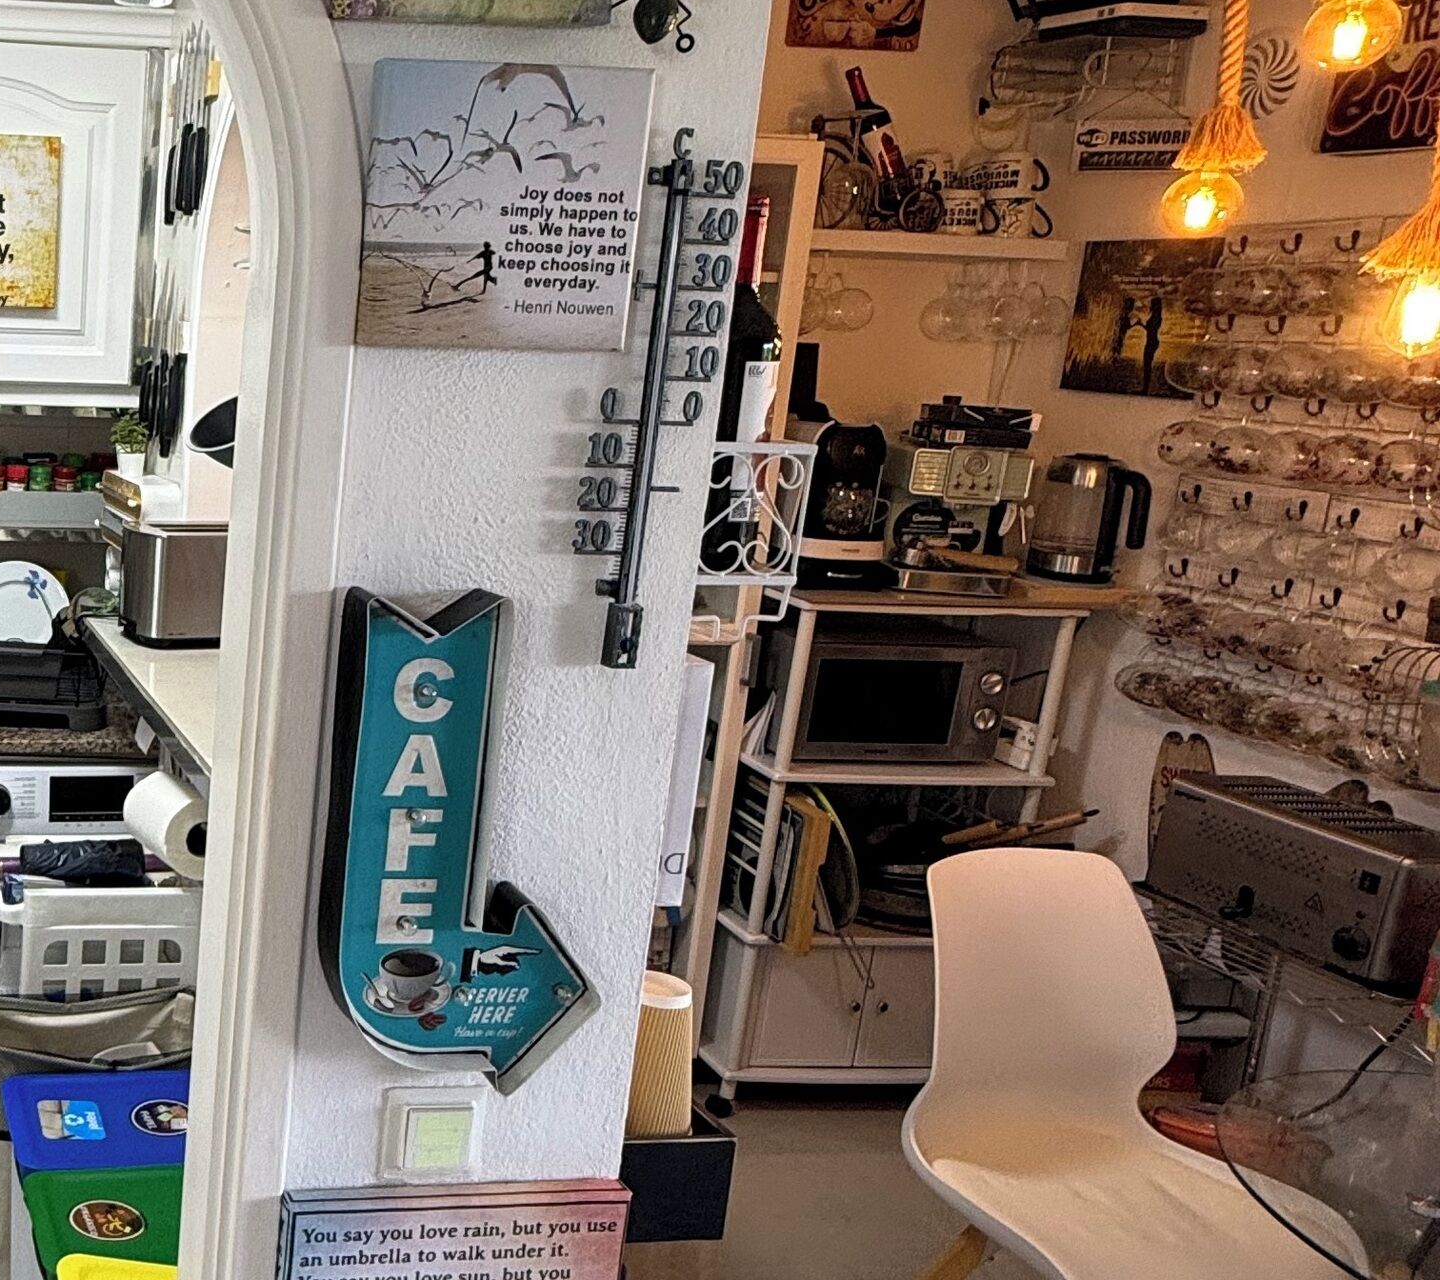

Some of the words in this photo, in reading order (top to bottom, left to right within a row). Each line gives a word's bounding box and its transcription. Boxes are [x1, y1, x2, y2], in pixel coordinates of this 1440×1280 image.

[703, 160, 744, 194] 50
[520, 186, 548, 203] Joy
[554, 187, 592, 202] does
[598, 191, 624, 203] not
[500, 203, 554, 221] simply
[559, 205, 618, 223] happen
[624, 209, 638, 221] to
[698, 208, 738, 241] 40
[524, 275, 600, 292] everyday.
[692, 254, 732, 287] 30
[514, 300, 552, 314] Henri
[556, 301, 614, 315] Nouwen
[686, 300, 726, 333] 20
[685, 346, 720, 378] 10
[600, 387, 618, 419] 0
[683, 391, 703, 421] 0
[587, 432, 622, 464] 10
[577, 476, 617, 507] 20
[572, 519, 610, 551] 30
[375, 657, 456, 945] CAFE
[468, 1006, 516, 1024] HERE
[302, 1227, 338, 1244] You
[343, 1229, 374, 1245] say
[380, 1229, 413, 1245] you
[420, 1224, 458, 1240] love
[463, 1224, 506, 1238] rain,
[512, 1221, 542, 1236] but
[548, 1221, 581, 1238] you
[587, 1220, 618, 1234] use
